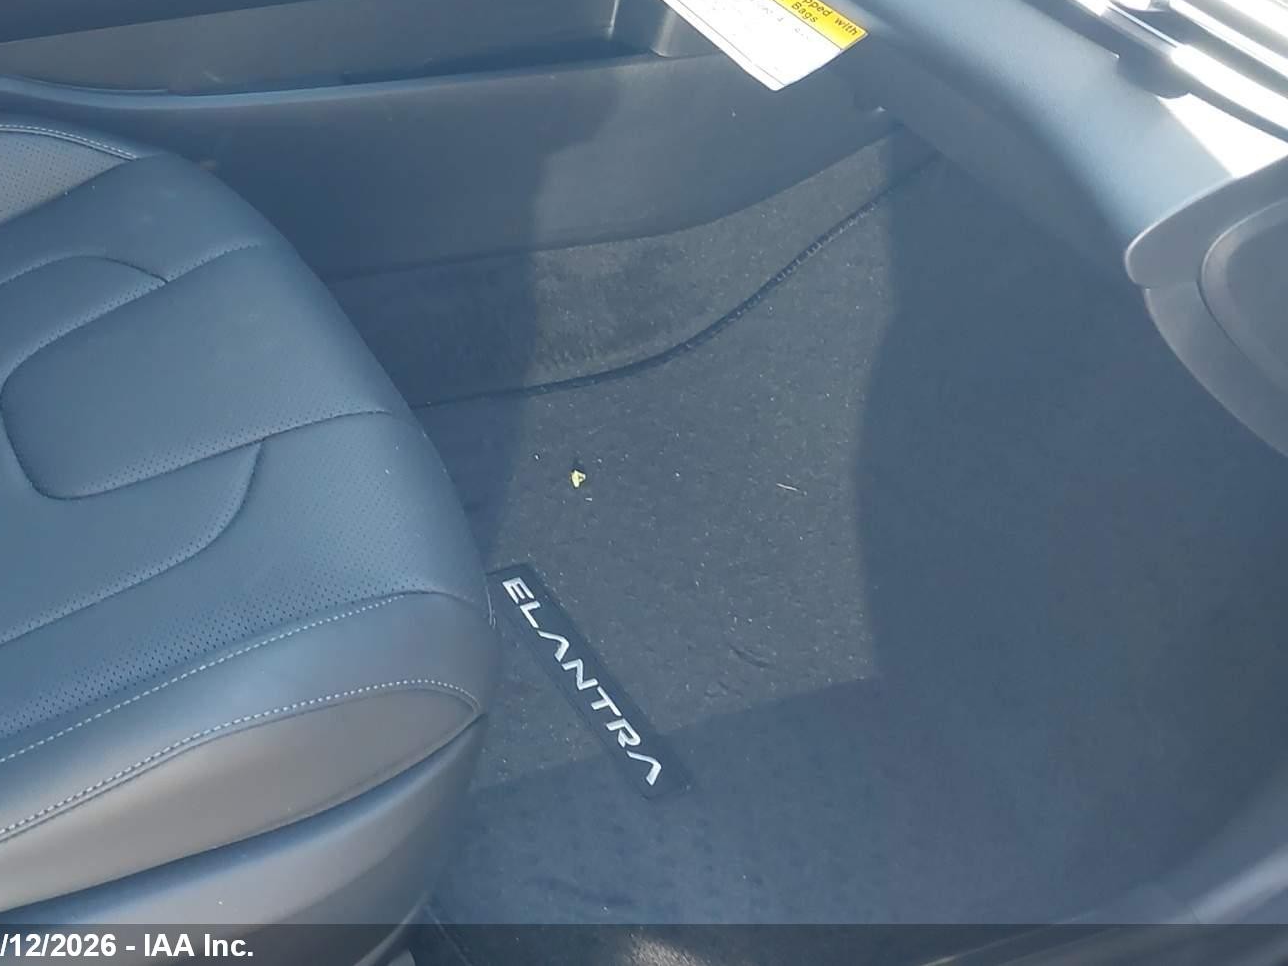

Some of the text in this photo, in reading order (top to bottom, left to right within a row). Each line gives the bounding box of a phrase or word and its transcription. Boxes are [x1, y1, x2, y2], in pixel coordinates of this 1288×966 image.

[791, 1, 819, 24] Bags
[834, 17, 859, 36] with
[502, 577, 662, 786] ELANTRA
